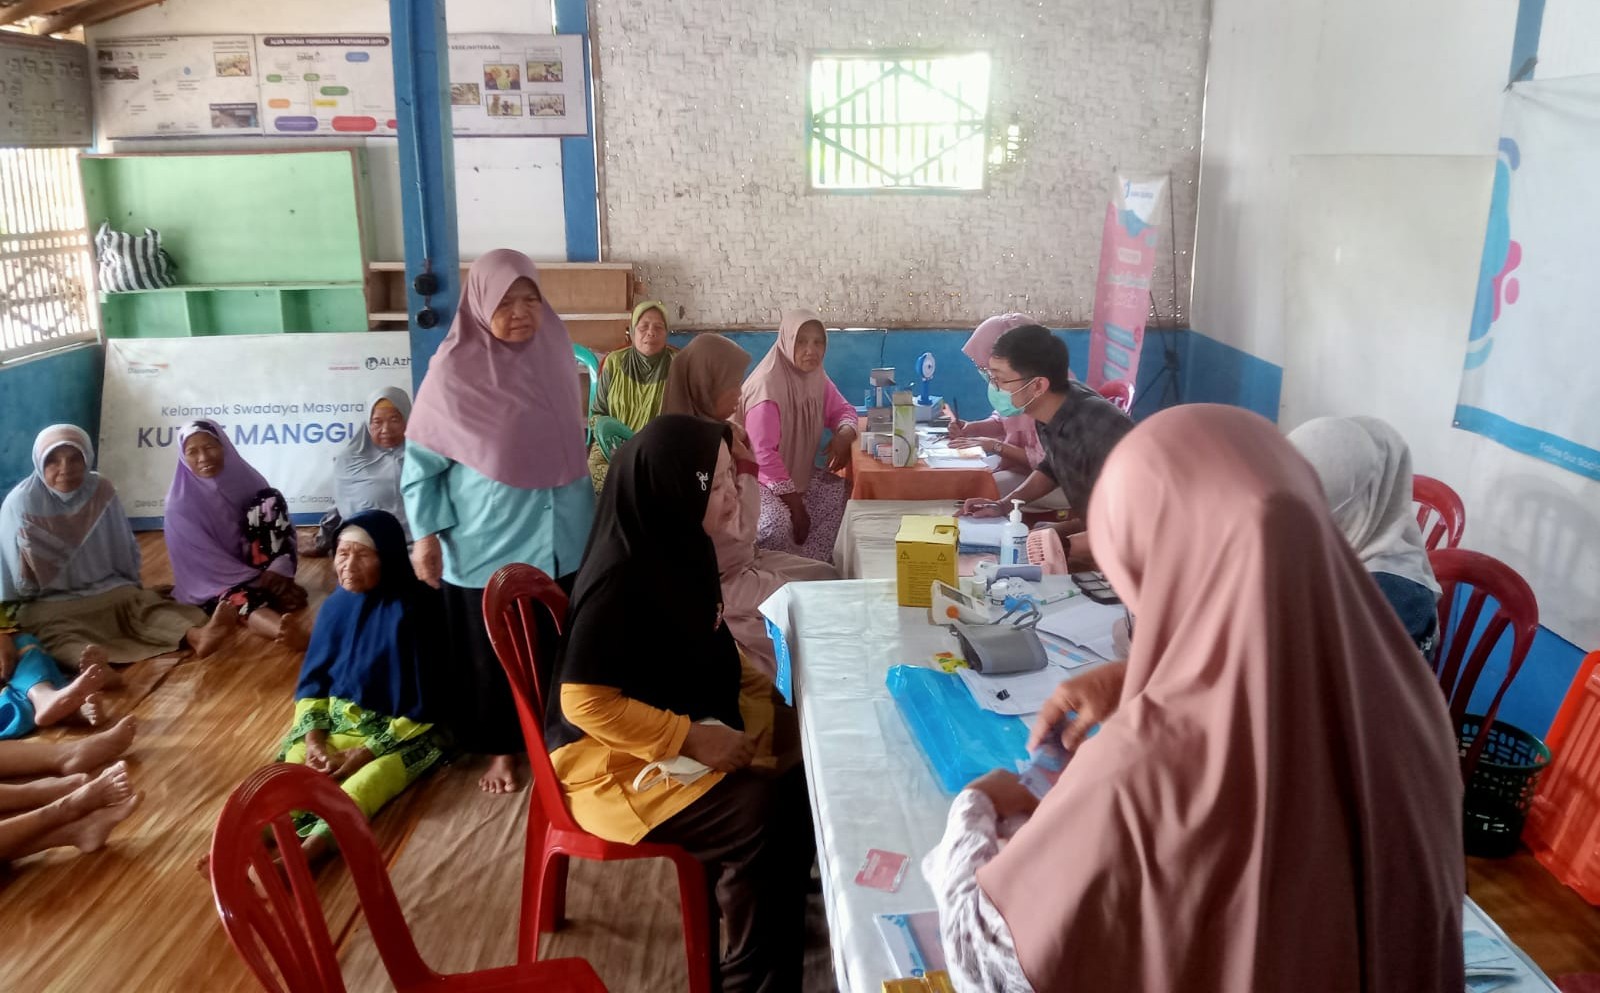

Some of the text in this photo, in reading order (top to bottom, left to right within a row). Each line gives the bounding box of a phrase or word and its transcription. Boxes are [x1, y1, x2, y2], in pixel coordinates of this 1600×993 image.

[161, 401, 366, 418] Kelompok Swadaya Masyara
